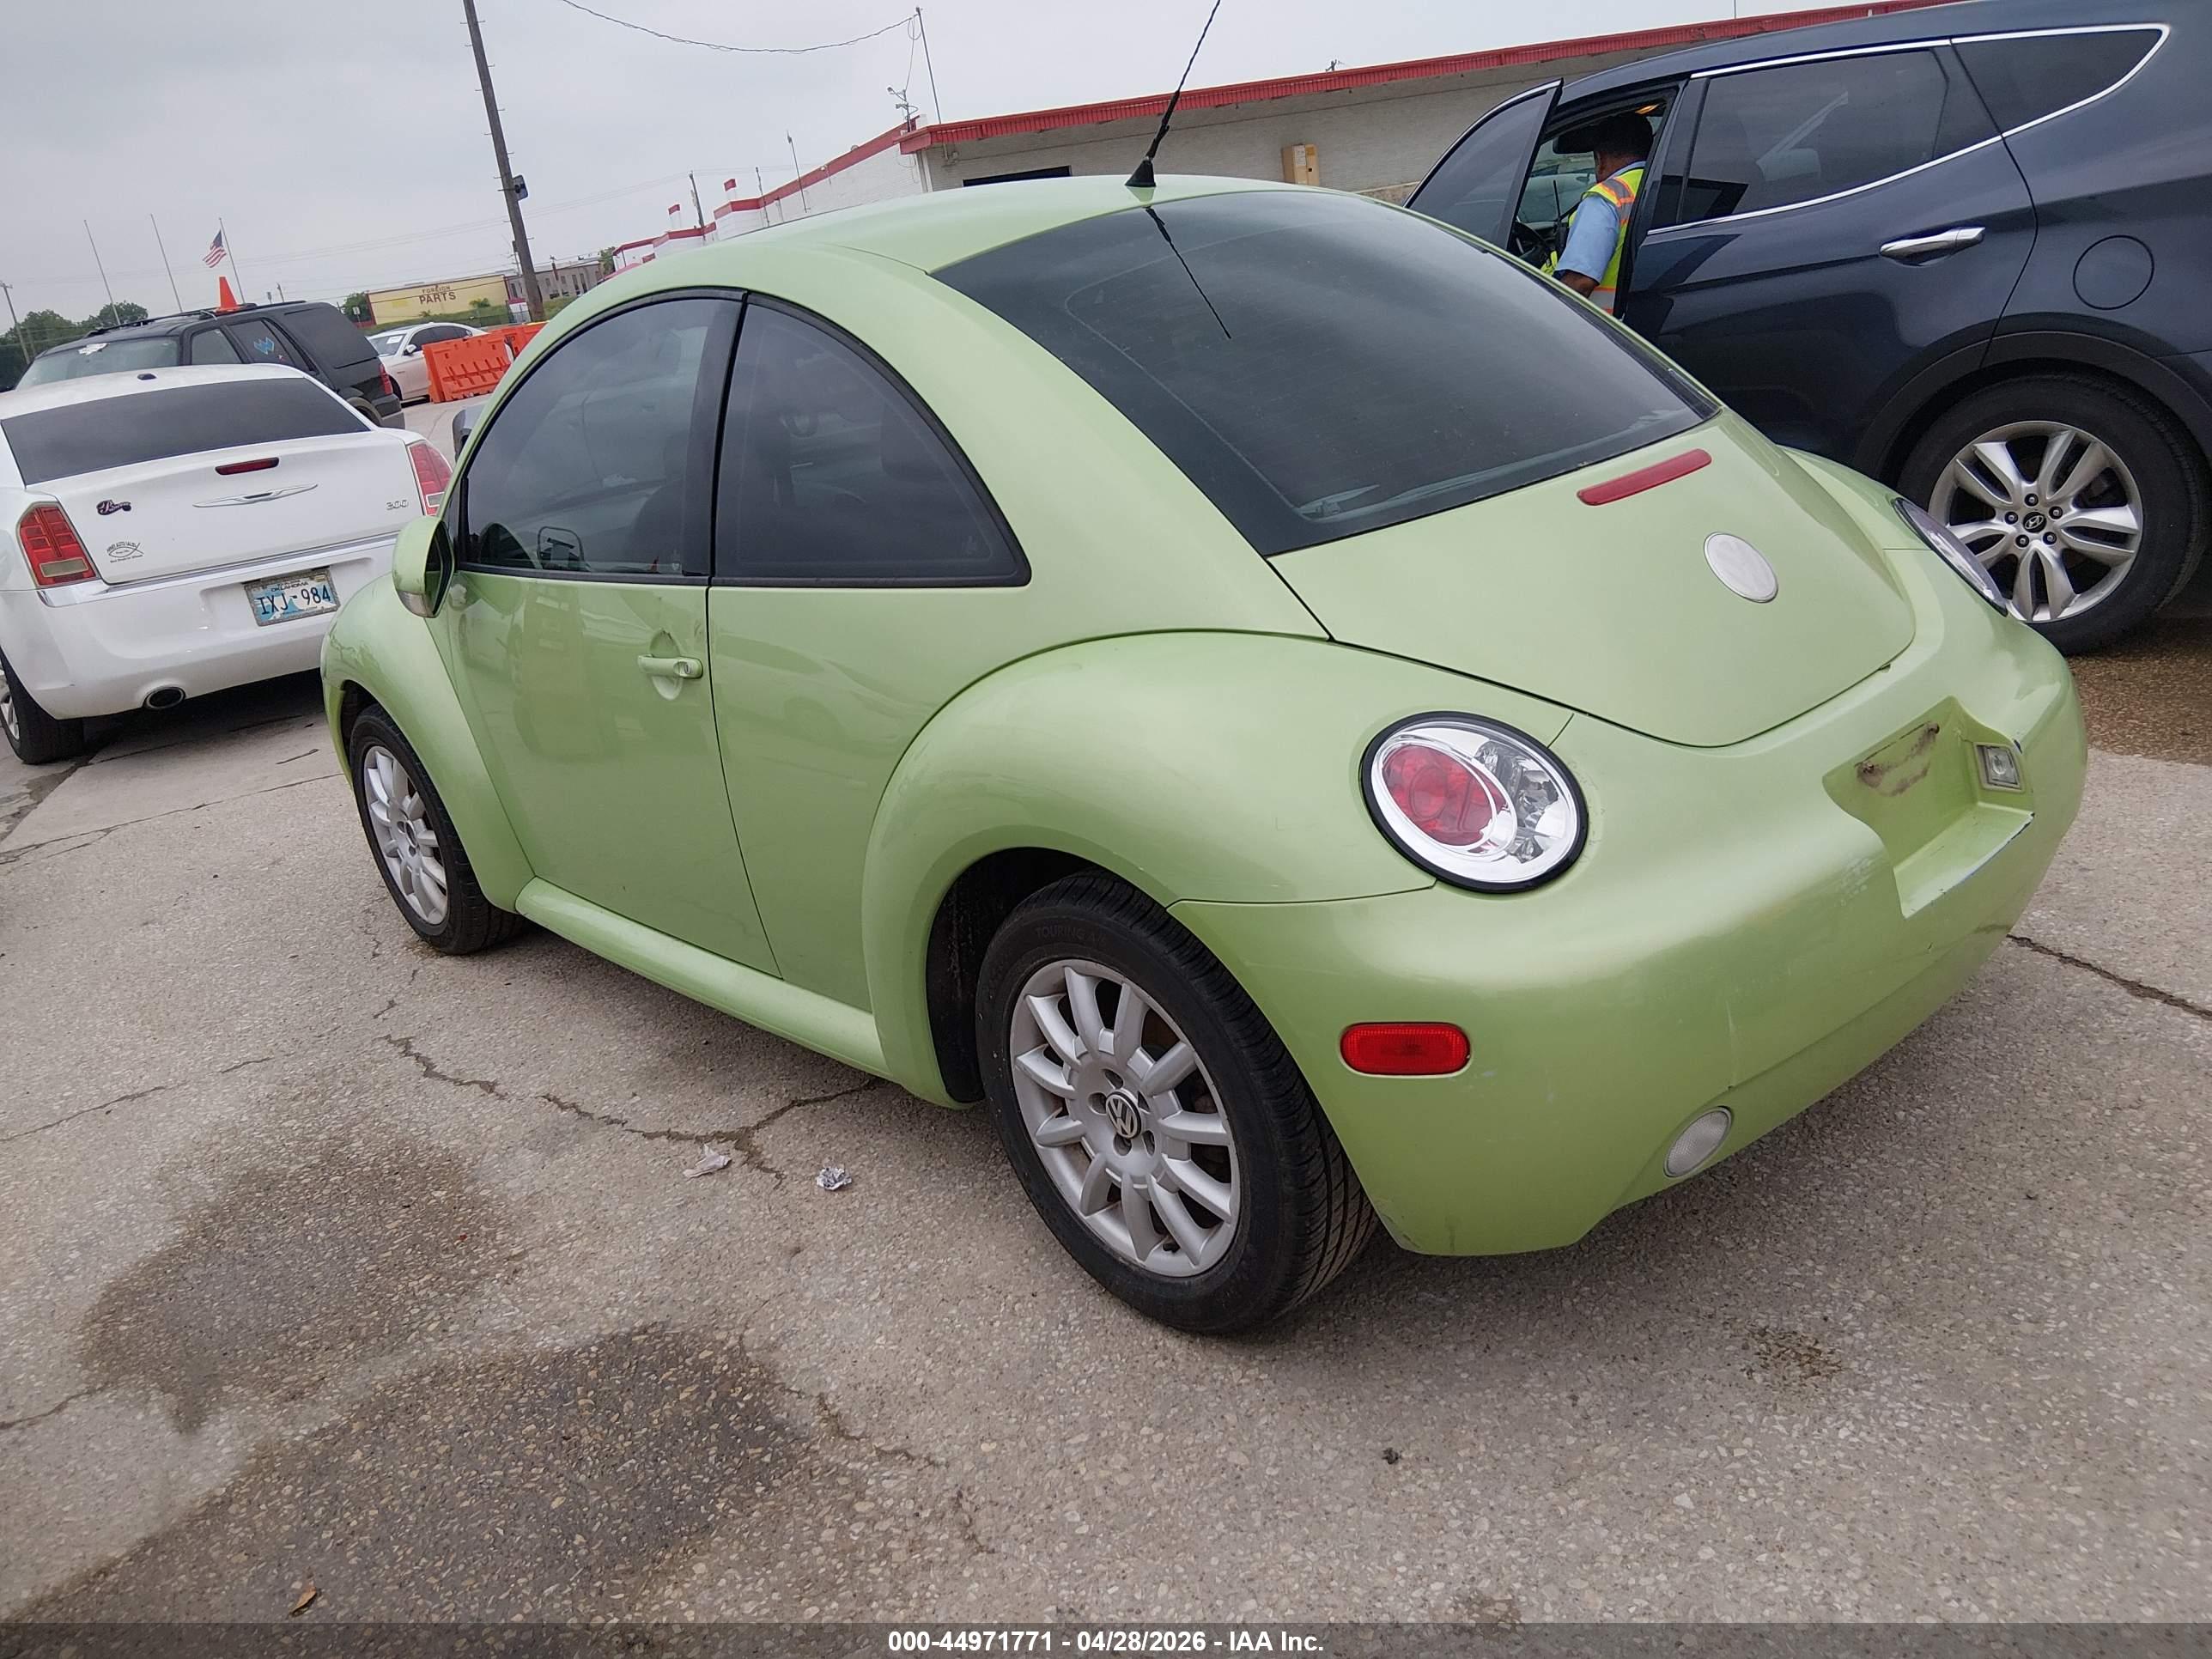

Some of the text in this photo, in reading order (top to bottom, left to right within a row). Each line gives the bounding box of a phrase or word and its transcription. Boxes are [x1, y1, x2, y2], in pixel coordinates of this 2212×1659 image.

[419, 292, 457, 304] PARTS
[386, 499, 410, 511] 300
[257, 584, 331, 615] IXJ-984
[1035, 925, 1085, 941] TOURING
